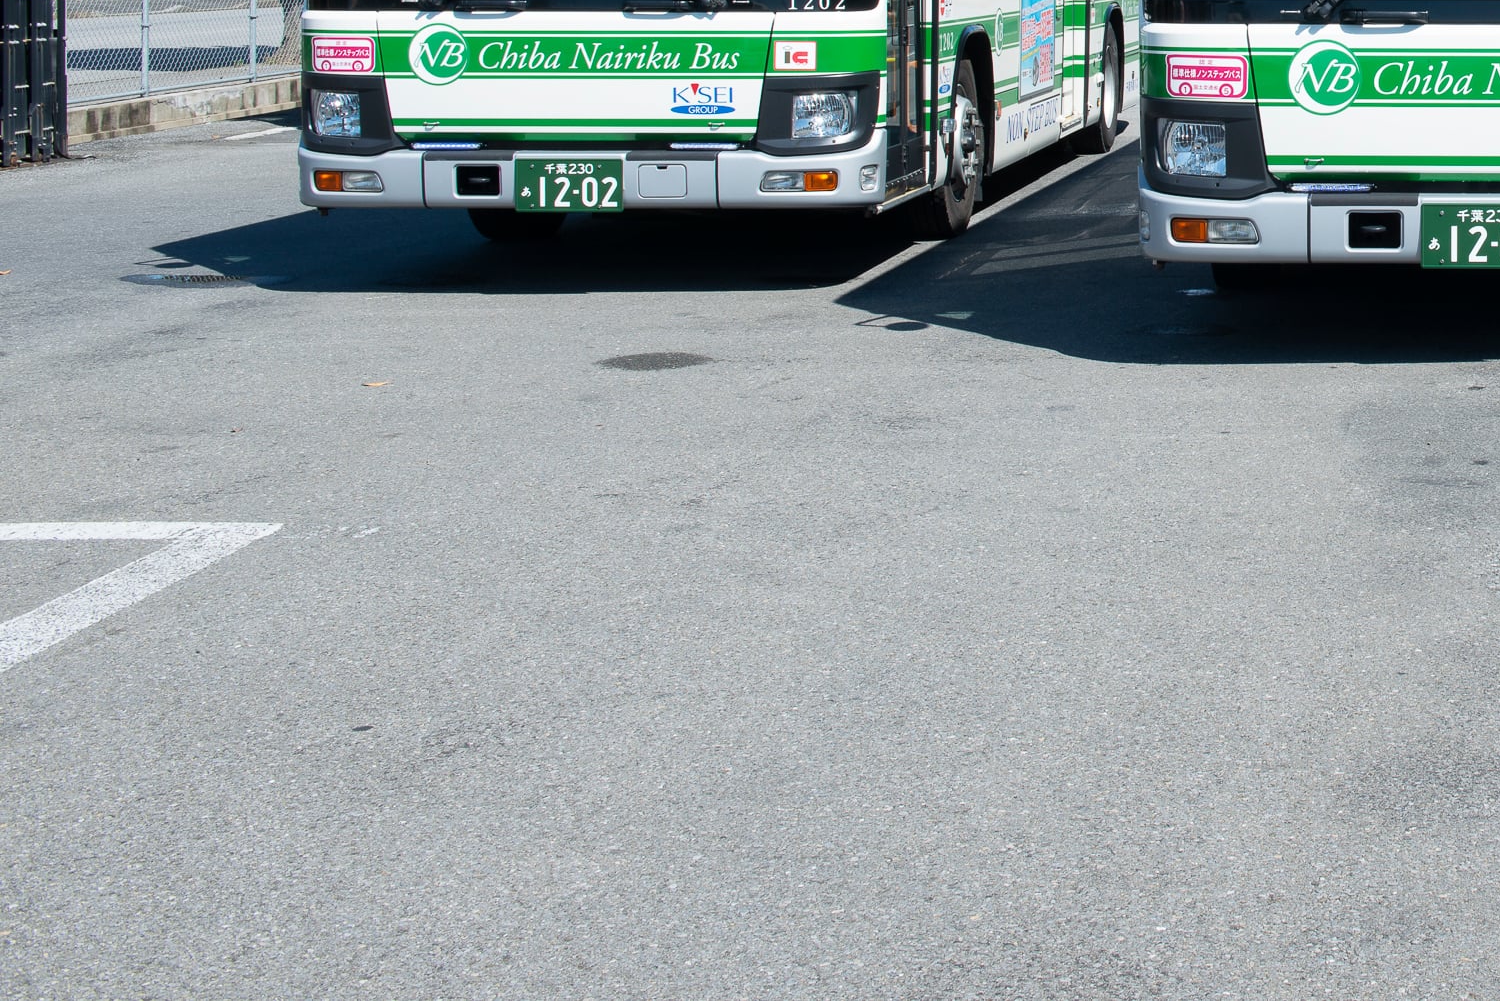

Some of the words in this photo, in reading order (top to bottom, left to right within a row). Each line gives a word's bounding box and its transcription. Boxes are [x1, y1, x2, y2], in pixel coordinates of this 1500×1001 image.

[939, 32, 954, 52] 1202
[478, 40, 561, 70] Chiba
[568, 41, 681, 70] Nairiku
[689, 42, 740, 70] Bus
[1373, 61, 1473, 96] Chiba
[688, 105, 718, 114] GROUP
[521, 186, 531, 197] あ
[539, 176, 618, 207] 12-02
[1428, 237, 1440, 250] あ
